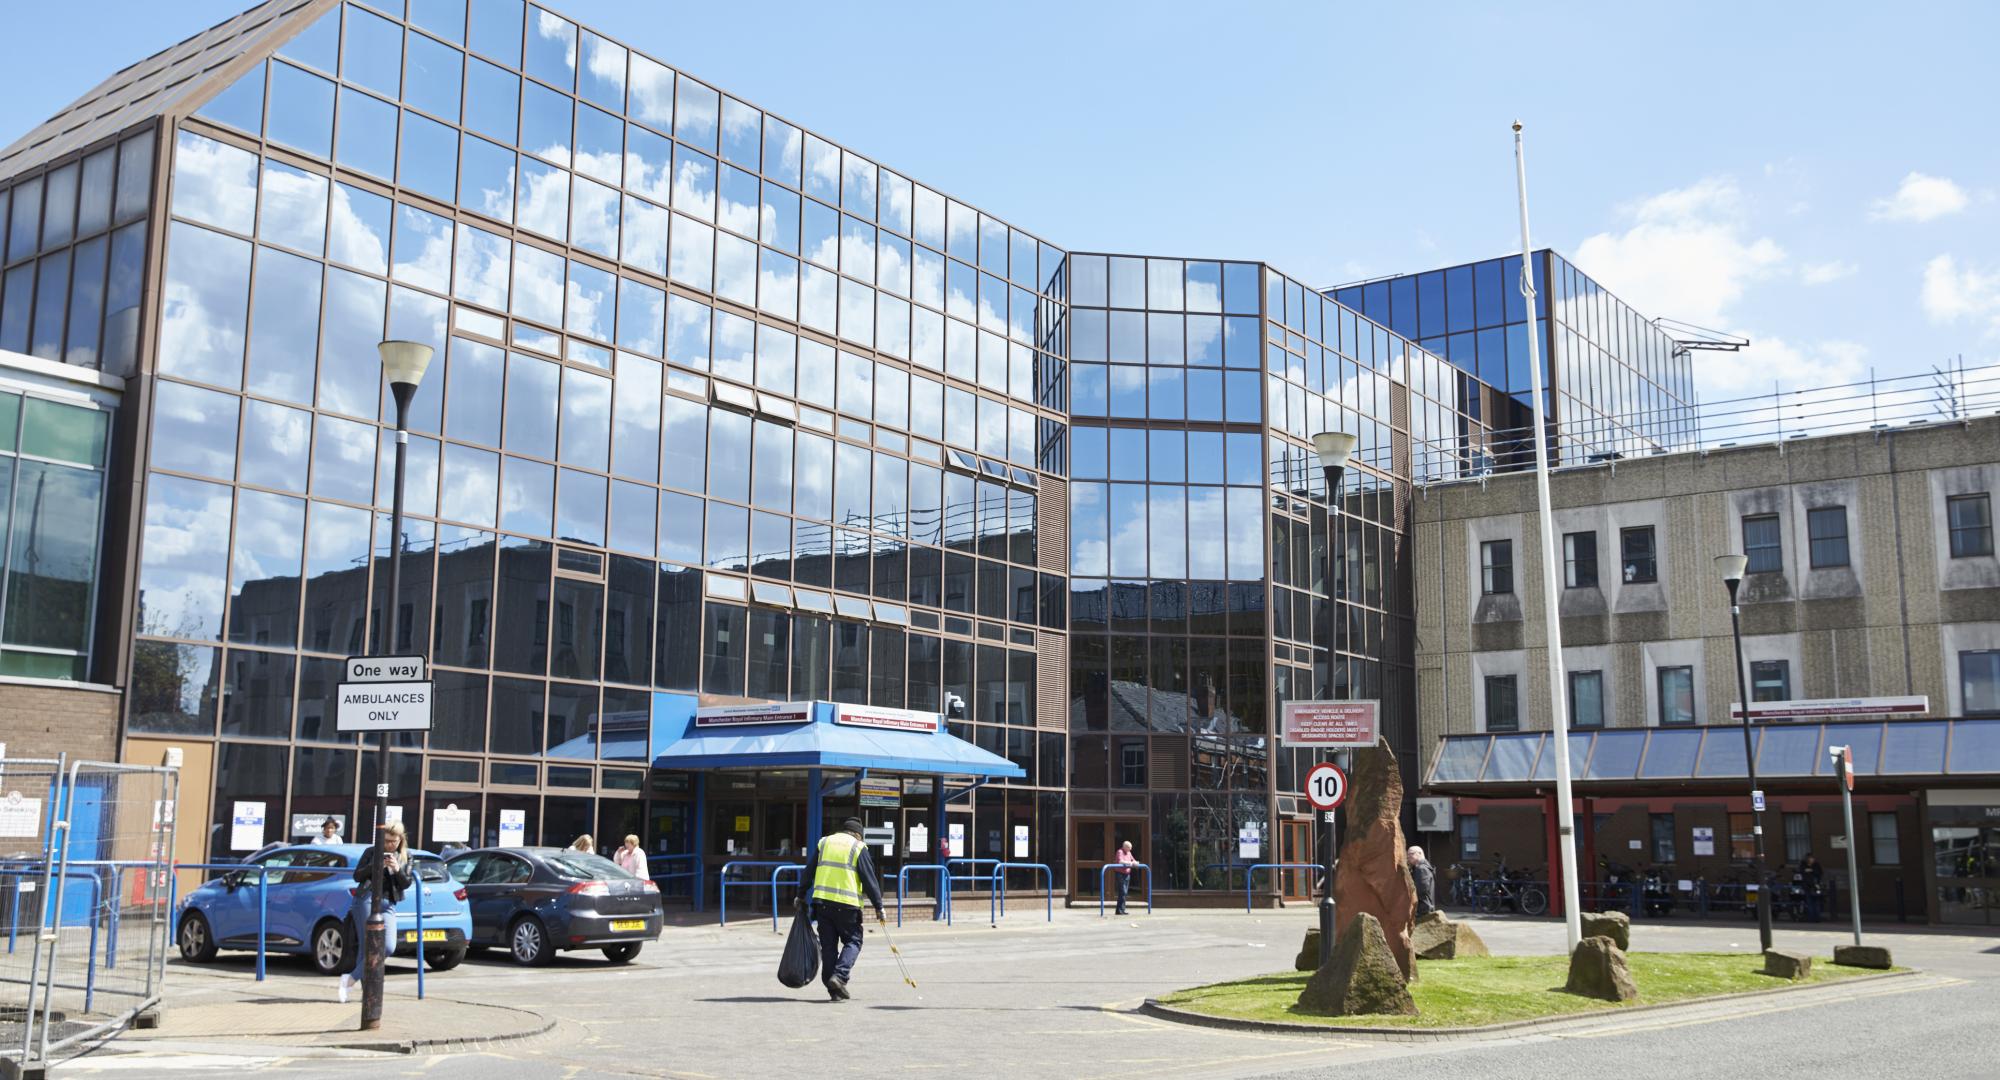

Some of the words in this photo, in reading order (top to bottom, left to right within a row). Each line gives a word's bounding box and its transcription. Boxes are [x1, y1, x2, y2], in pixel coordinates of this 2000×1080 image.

[353, 664, 381, 677] One
[389, 666, 418, 678] way
[344, 693, 425, 704] AMBULANCES
[368, 711, 399, 721] ONLY
[1314, 776, 1338, 797] 10
